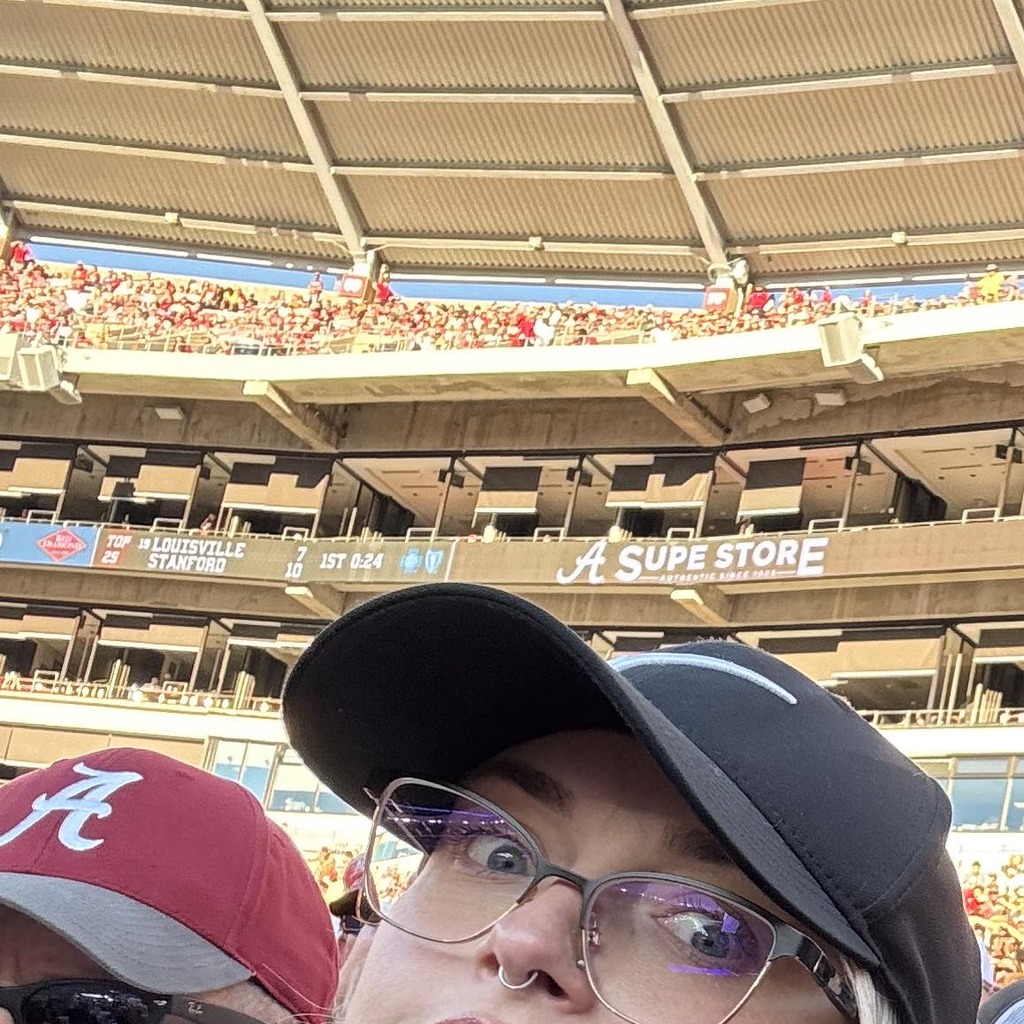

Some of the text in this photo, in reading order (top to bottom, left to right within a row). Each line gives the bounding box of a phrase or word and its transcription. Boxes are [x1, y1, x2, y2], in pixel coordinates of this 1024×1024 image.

[106, 534, 133, 549] TOP
[151, 537, 246, 558] LOUISVILLE
[101, 550, 120, 564] 25
[147, 553, 227, 573] STANFORD
[297, 546, 308, 563] 7
[319, 552, 384, 570] 1ST 0:24
[556, 537, 830, 585] A SUPE STORE
[284, 562, 304, 578] 10
